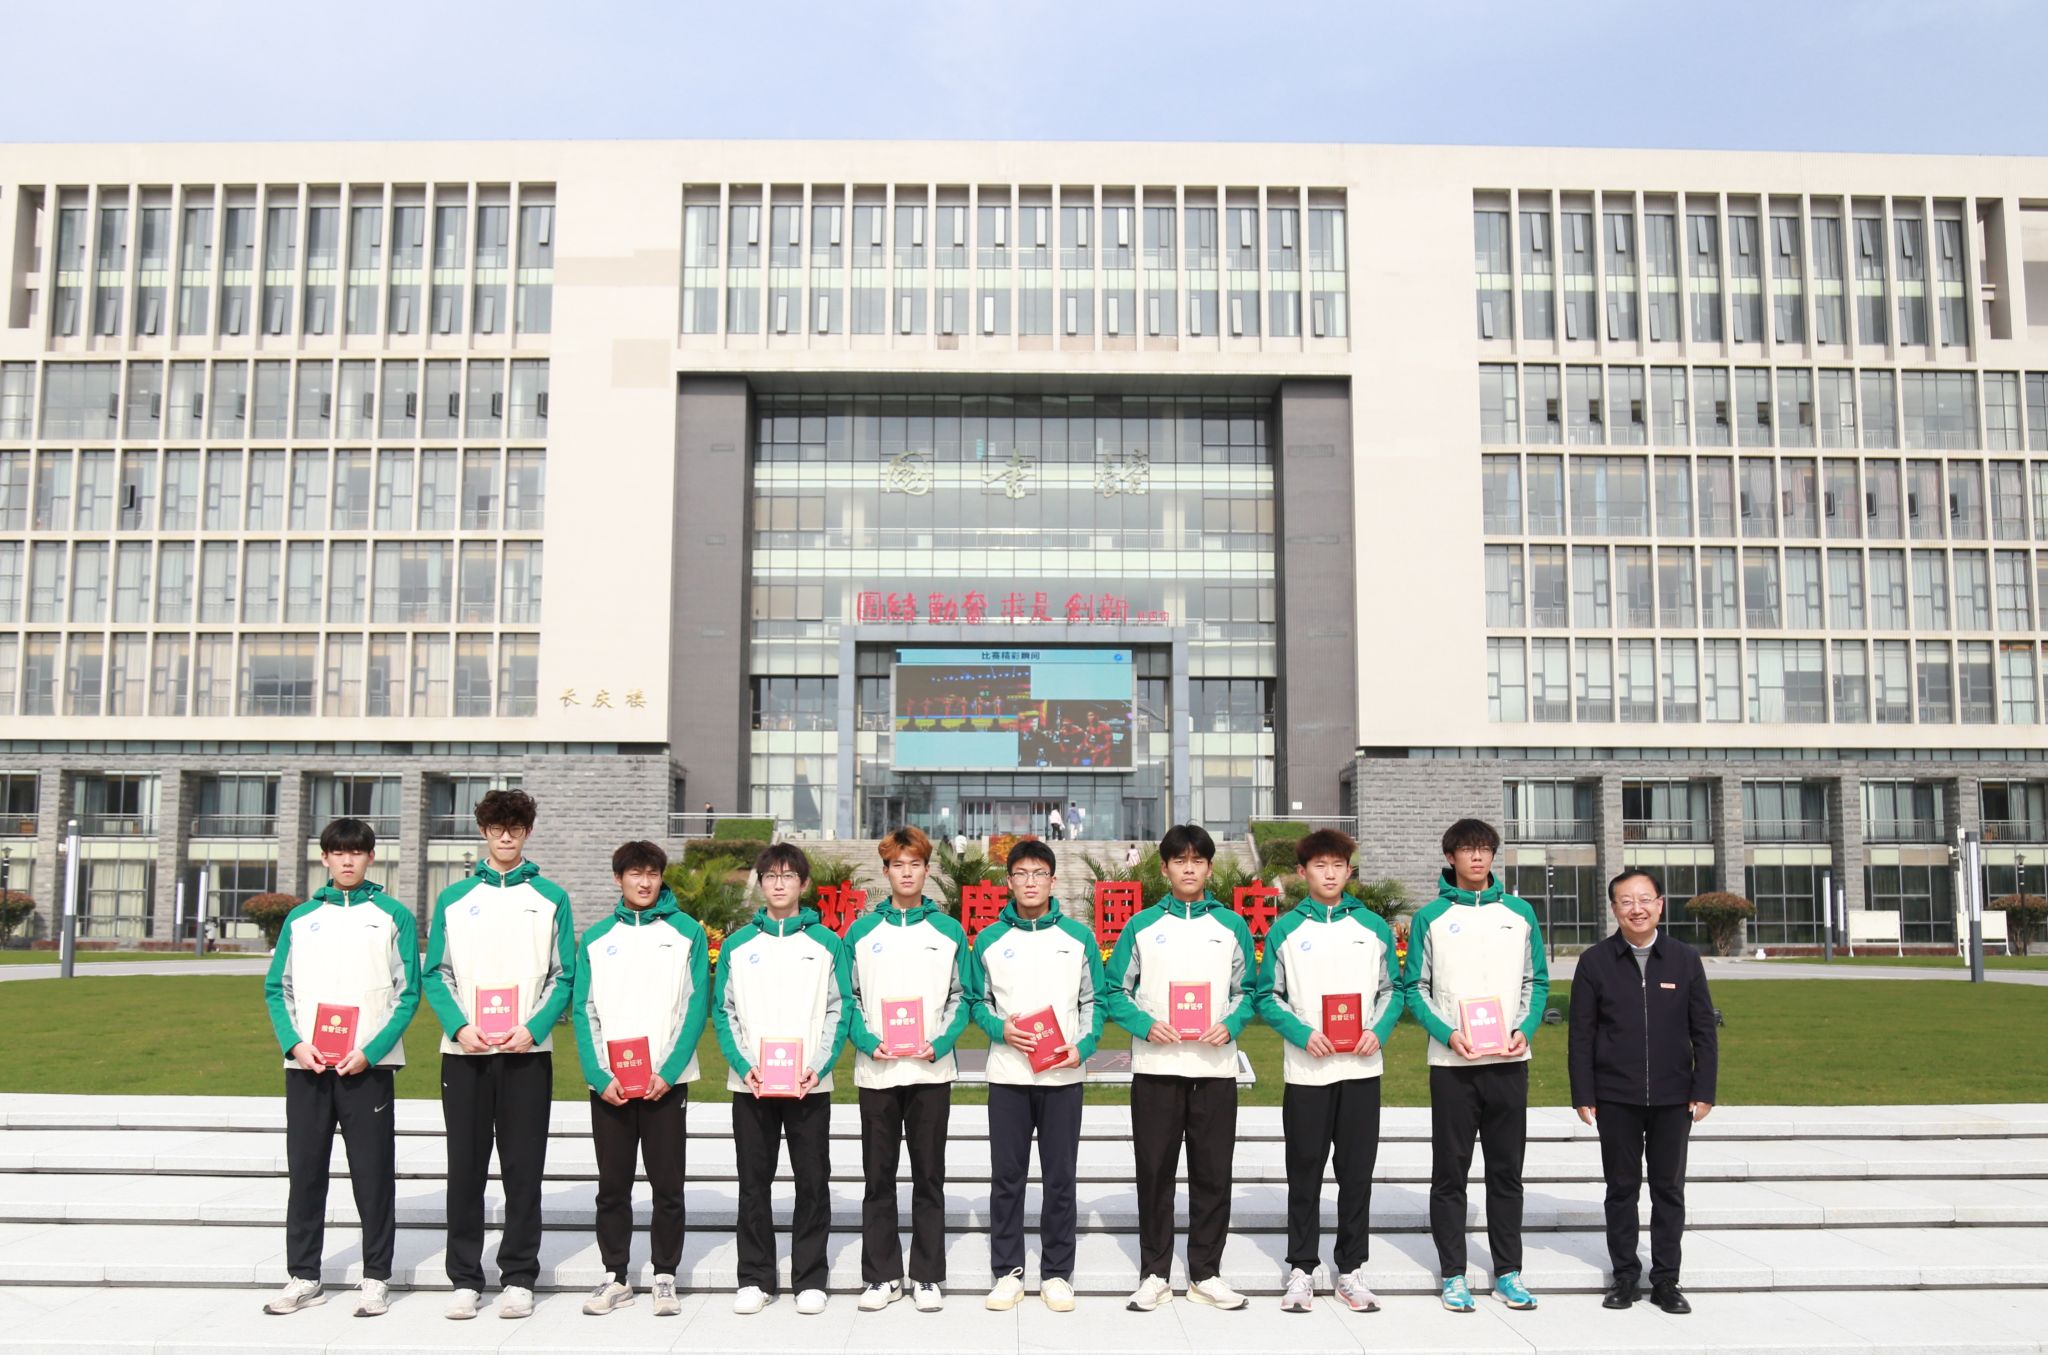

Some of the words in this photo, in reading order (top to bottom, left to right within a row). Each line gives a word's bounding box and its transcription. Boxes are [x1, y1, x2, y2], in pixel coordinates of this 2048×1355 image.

[981, 651, 1040, 660] 比赛精彩瞬间
[1177, 1002, 1203, 1010] 荣誉证书
[1330, 1013, 1355, 1021] 荣誉证书
[321, 1024, 348, 1034] 荣誉证书
